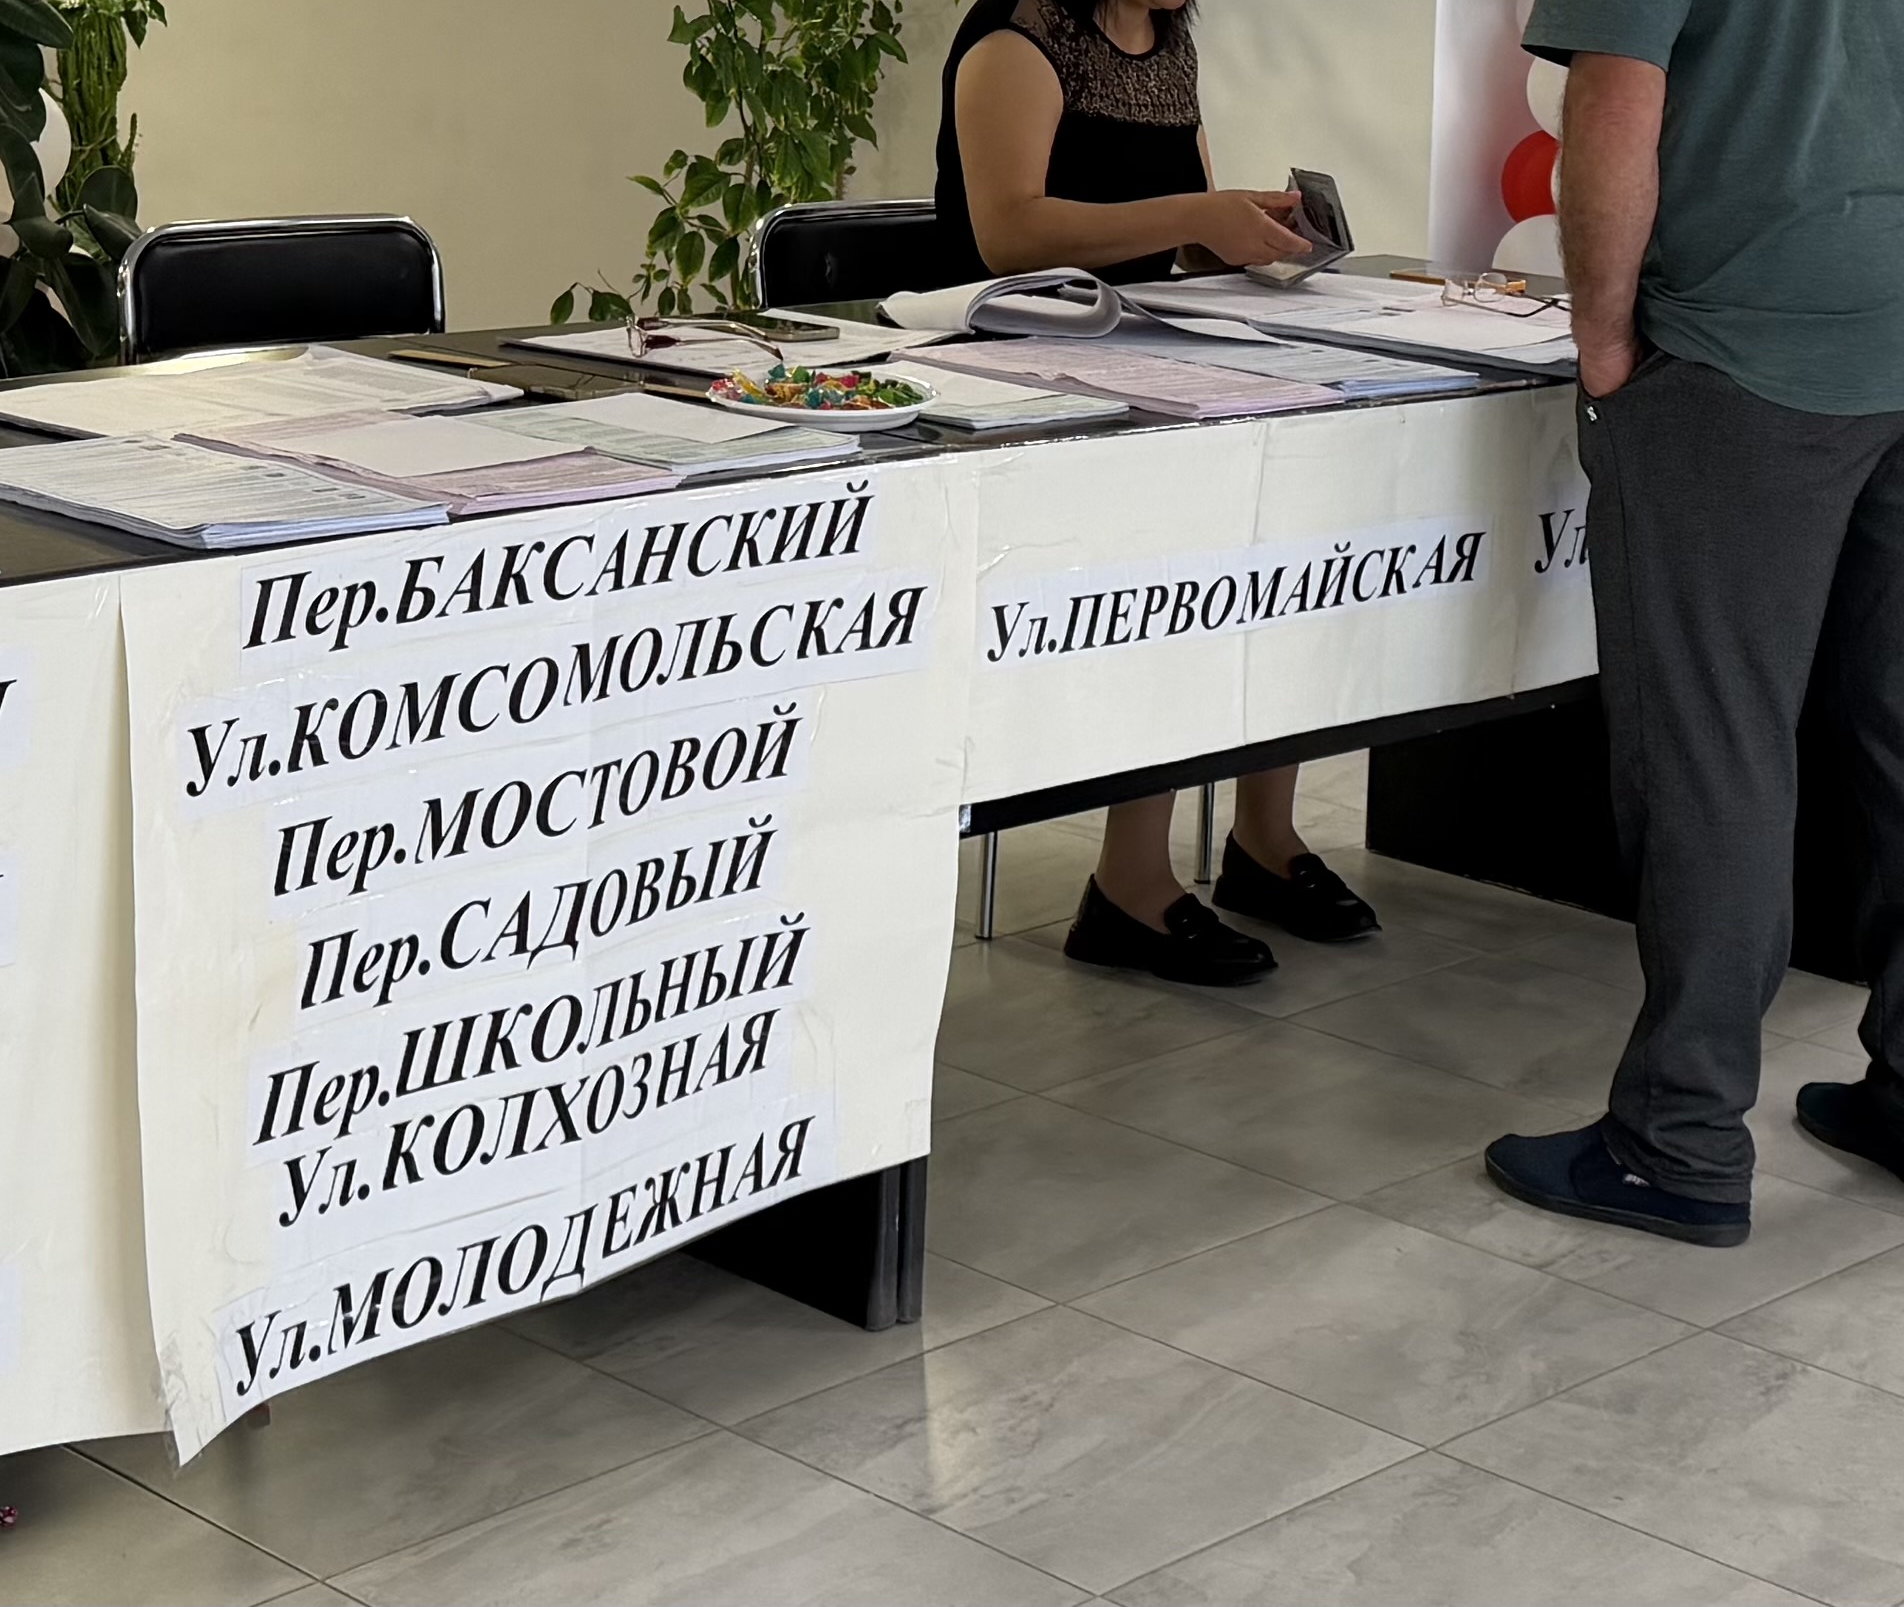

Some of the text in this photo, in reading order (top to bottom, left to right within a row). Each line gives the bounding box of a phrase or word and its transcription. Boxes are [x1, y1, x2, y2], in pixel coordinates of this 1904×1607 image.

[241, 480, 874, 651] Пер.БАКСАНСКИЙ
[986, 530, 1487, 663] Ул.ПЕРВОМАЙСКАЯ
[185, 586, 925, 798] Ул.КОМСОМОЛЬСКАЯ
[273, 701, 803, 898] Пер.МОСТОВОЙ
[300, 812, 778, 1011] Пер.САДОВЫЙ
[252, 910, 810, 1147] Пер.ШКОЛЬНЫЙ
[235, 1116, 813, 1397] Ул.МОЛОДЕЖНАЯ
